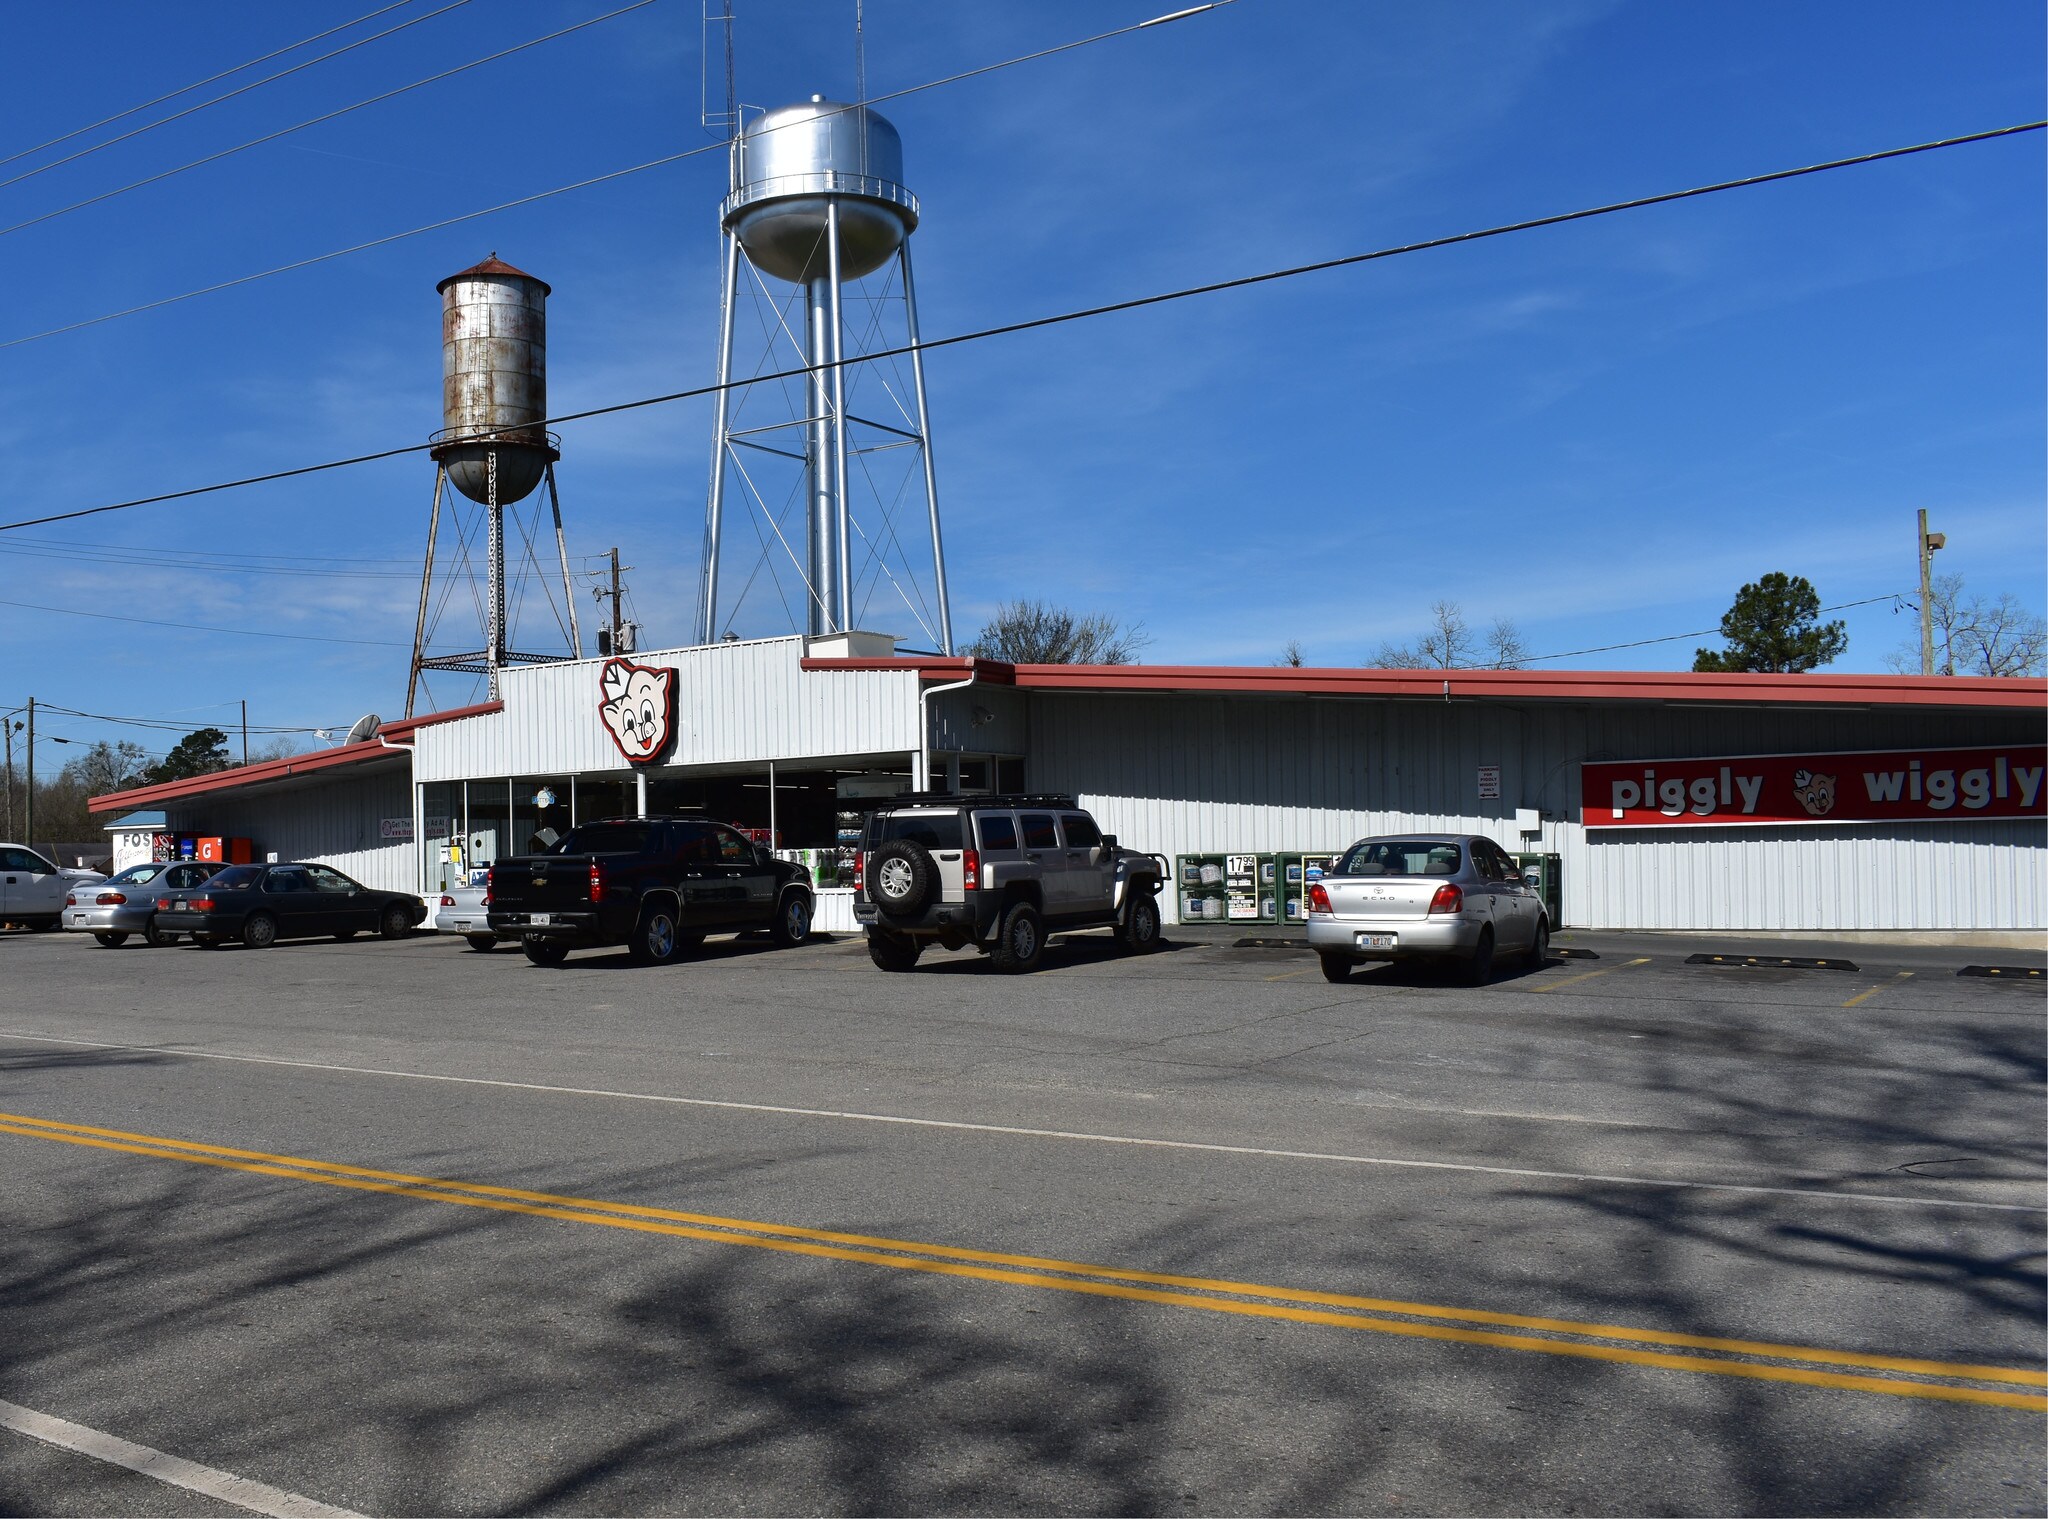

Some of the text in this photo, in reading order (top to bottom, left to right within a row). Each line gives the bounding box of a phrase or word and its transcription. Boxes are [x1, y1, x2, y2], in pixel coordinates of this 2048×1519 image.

[1612, 757, 2044, 819] piggly wiggly
[391, 820, 400, 828] Get
[401, 820, 410, 828] The
[123, 833, 150, 847] FOS
[202, 843, 211, 858] G
[471, 871, 489, 885] AT
